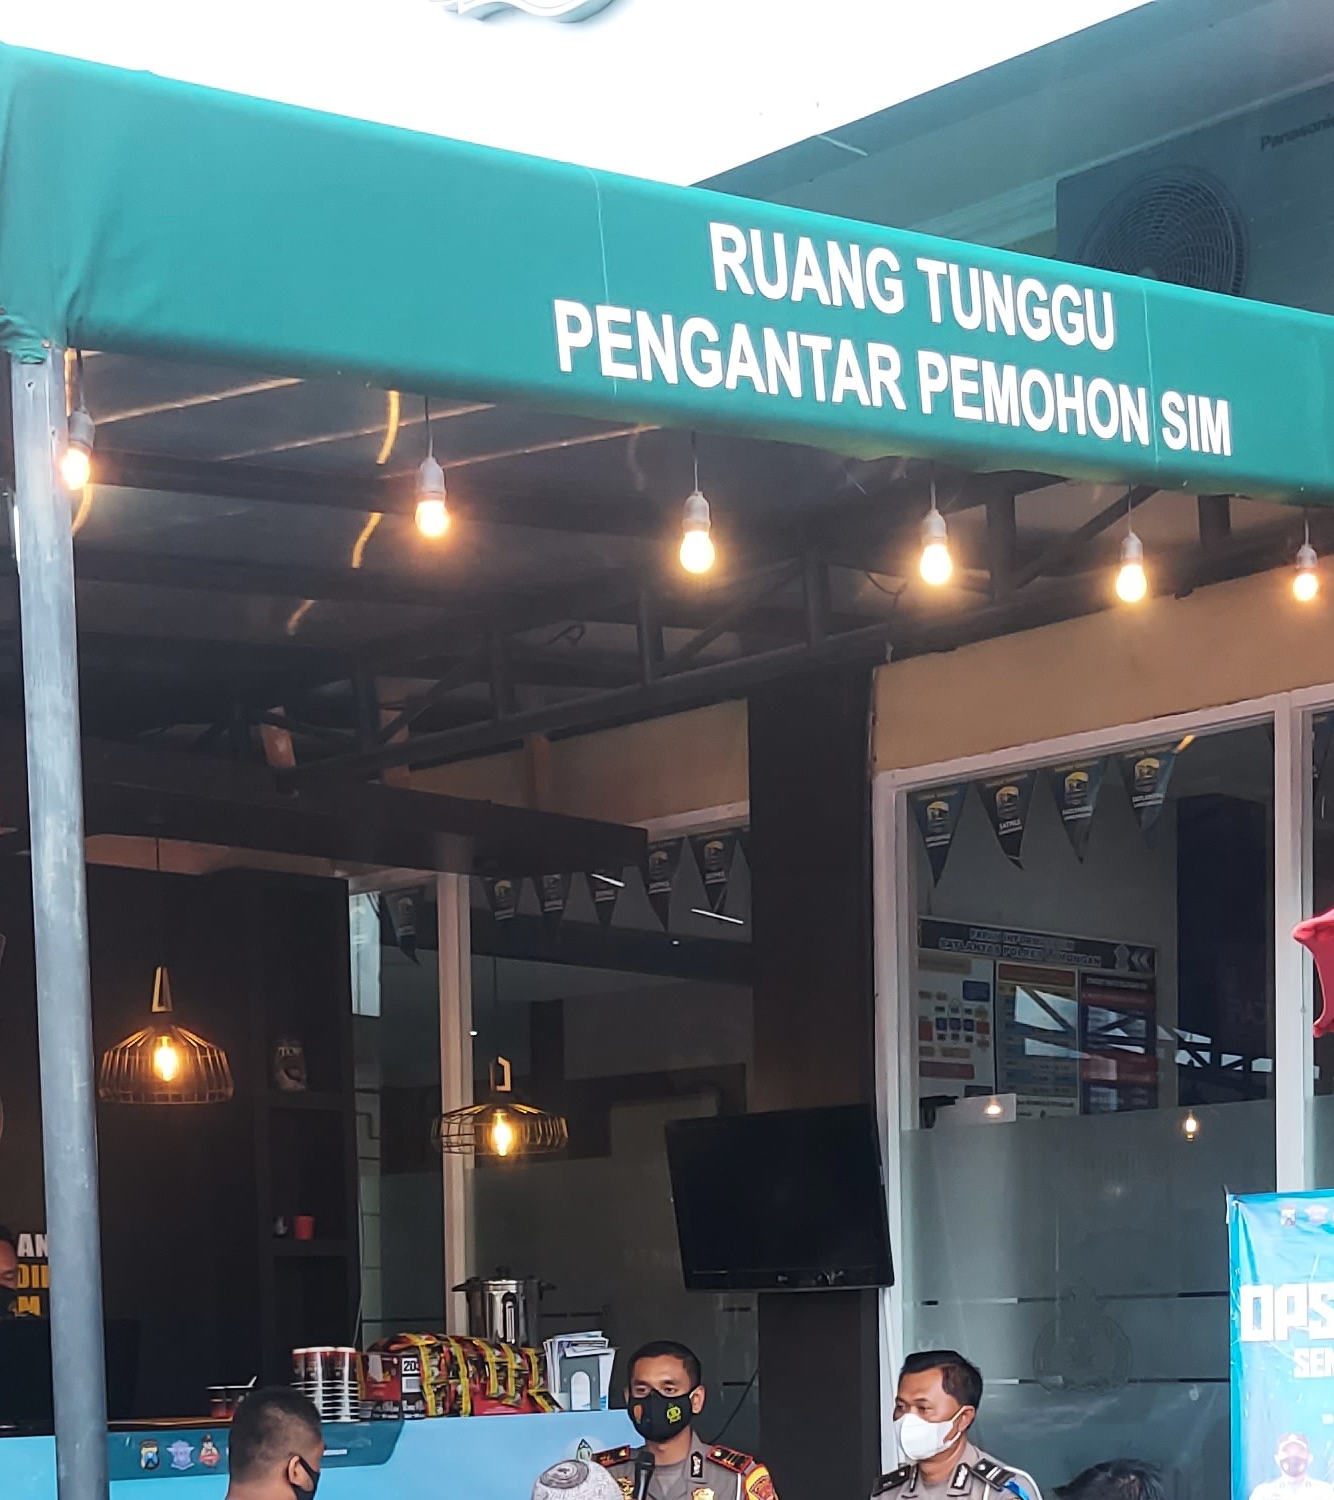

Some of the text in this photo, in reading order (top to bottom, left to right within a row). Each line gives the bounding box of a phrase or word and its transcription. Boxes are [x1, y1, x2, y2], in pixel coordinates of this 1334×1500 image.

[709, 221, 1116, 351] RUANG TUNGGU
[554, 299, 1232, 457] PENGANTAR PEMOHON SIM
